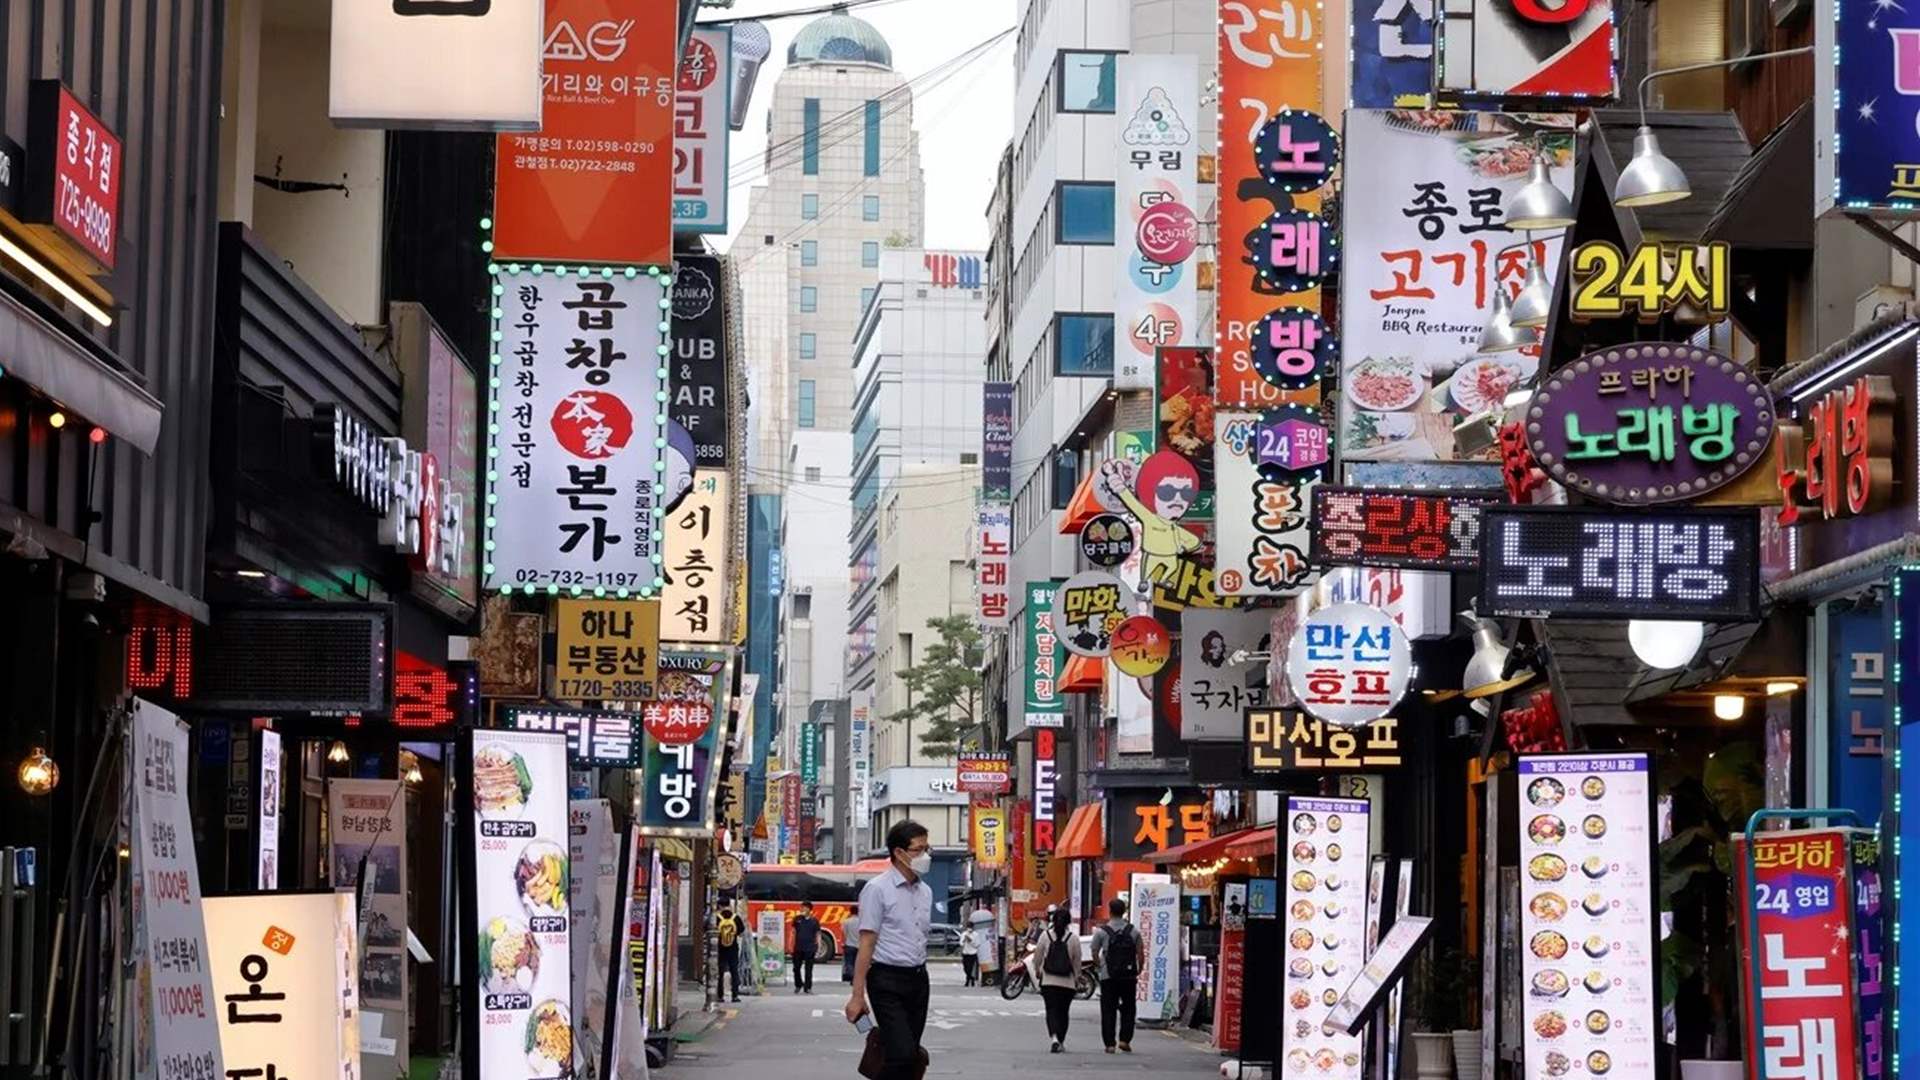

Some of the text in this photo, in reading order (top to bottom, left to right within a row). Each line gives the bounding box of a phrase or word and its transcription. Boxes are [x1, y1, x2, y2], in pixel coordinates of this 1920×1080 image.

[543, 73, 672, 106] 기리와 이규동
[67, 109, 112, 194] 종각점
[514, 136, 654, 154] 가맹문의 T.02)598-0290
[1129, 150, 1182, 171] 무림
[60, 172, 111, 254] 725-9998
[1402, 181, 1515, 241] 종로
[1270, 123, 1326, 376] 노래방
[672, 287, 711, 298] ANKA
[1575, 243, 1728, 314] 24시
[561, 281, 628, 386] 곱창
[1133, 313, 1177, 346] 4F
[1382, 320, 1484, 335] BBQ Restaura
[510, 284, 543, 489] 한우곱창전문점
[680, 364, 692, 380] &
[1600, 366, 1694, 399] 프라하
[561, 394, 614, 456] 本家
[1294, 428, 1323, 447] 코인
[1564, 402, 1740, 462] 노래방
[1261, 429, 1291, 463] 24
[1776, 374, 1871, 527] 노래방
[555, 463, 622, 562] 본가
[633, 479, 651, 558] 종로직영점
[1084, 541, 1132, 556] 당구클럽
[1248, 477, 1312, 593] 포차
[515, 568, 638, 587] 02-732-1197
[673, 505, 714, 634] 이층집
[981, 531, 1009, 618] 노래방
[1496, 521, 1735, 600] 노래방
[1223, 573, 1240, 589] B1
[1065, 584, 1119, 623] 만화
[581, 610, 634, 639] 하나
[1305, 623, 1392, 662] 만선
[567, 645, 647, 676] 부동산
[658, 655, 704, 670] UXURY
[1034, 611, 1056, 701] 자담치킨
[559, 679, 654, 699] T.720-3335
[1305, 668, 1391, 706] 호프
[642, 704, 711, 728] 羊肉串
[1249, 711, 1402, 768] 만선호프
[1035, 730, 1055, 850] BEER
[481, 840, 508, 851] 25,000
[483, 822, 533, 836] 한우 곱창구이
[1755, 838, 1835, 870] 프라하
[148, 870, 190, 906] 11,000원
[1756, 883, 1829, 914] 24 영업
[153, 936, 201, 973] 치즈떡볶이
[158, 984, 206, 1026] 11,000원
[485, 1013, 513, 1024] 25,000
